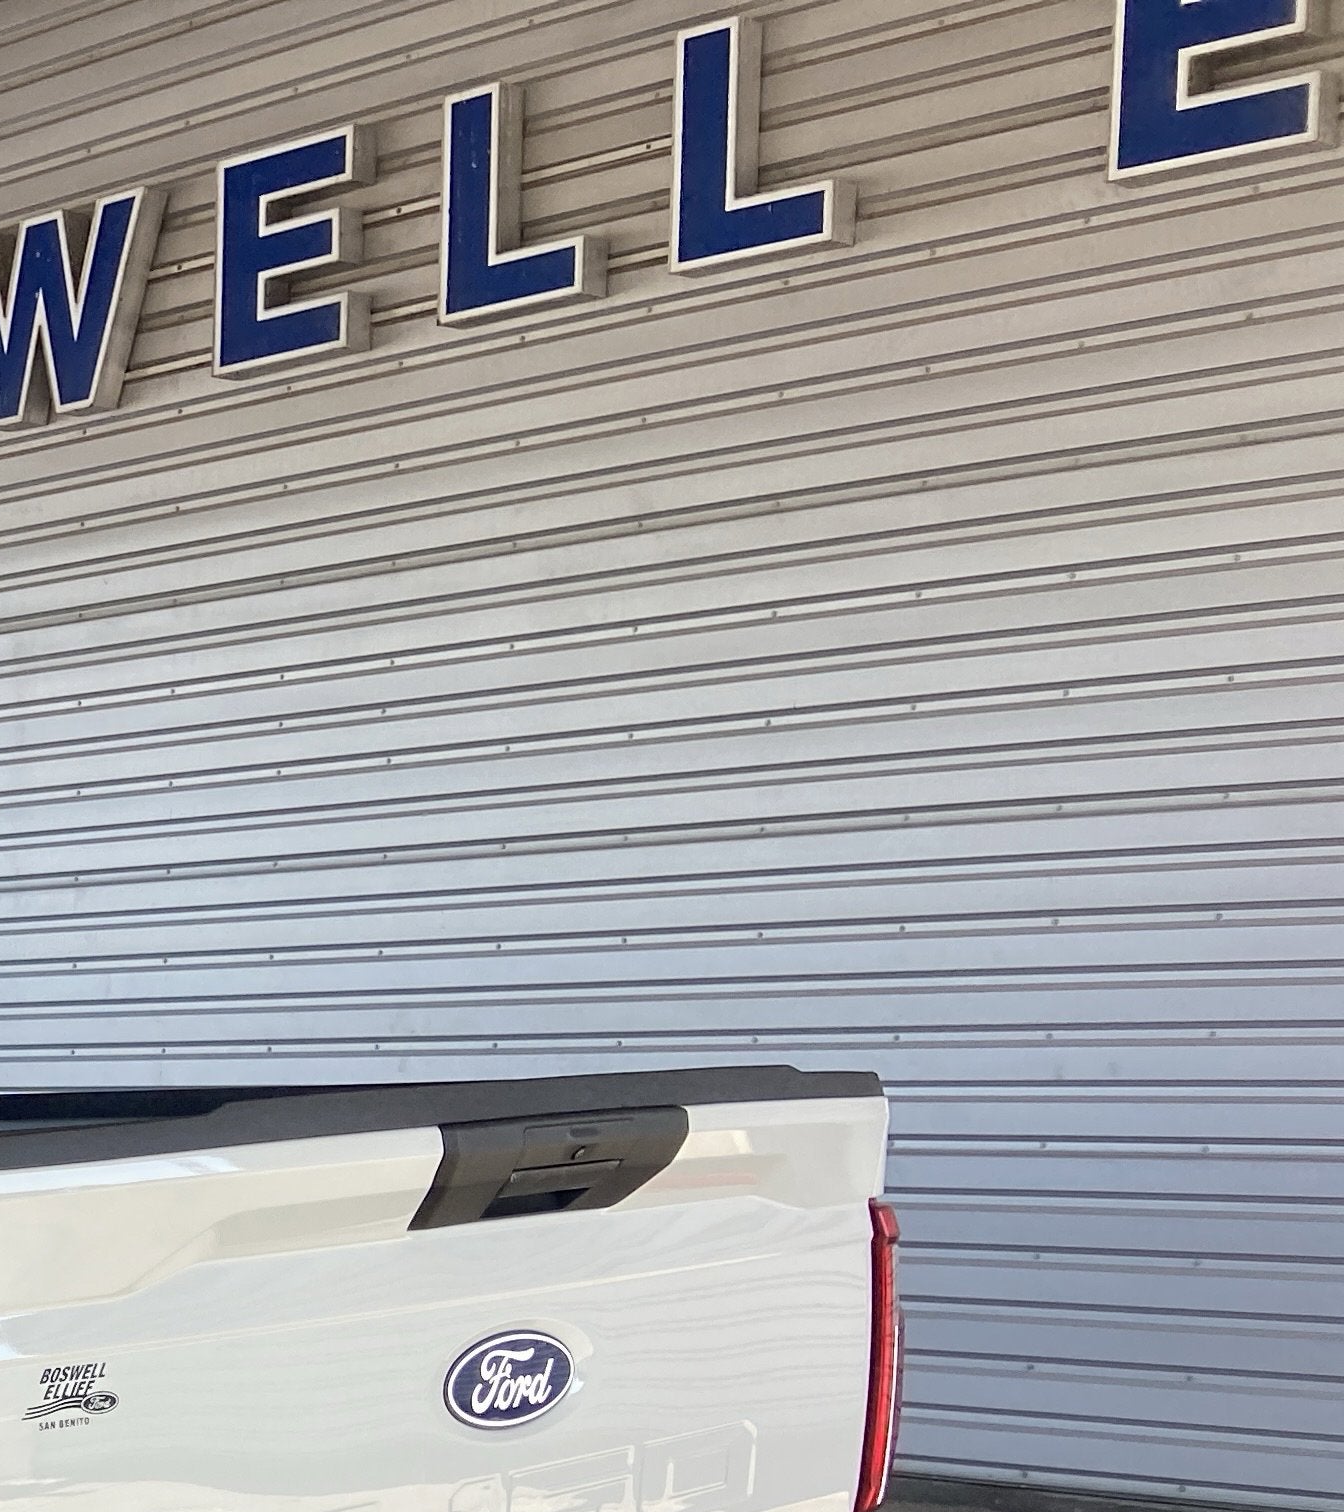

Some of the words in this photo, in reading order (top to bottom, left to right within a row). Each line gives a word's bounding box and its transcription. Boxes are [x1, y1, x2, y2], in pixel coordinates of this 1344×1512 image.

[40, 1362, 107, 1385] BOSWELL
[471, 1347, 554, 1414] Ford
[44, 1380, 95, 1400] ELLIFF
[39, 1421, 56, 1431] SAN
[59, 1417, 90, 1429] BENITO
